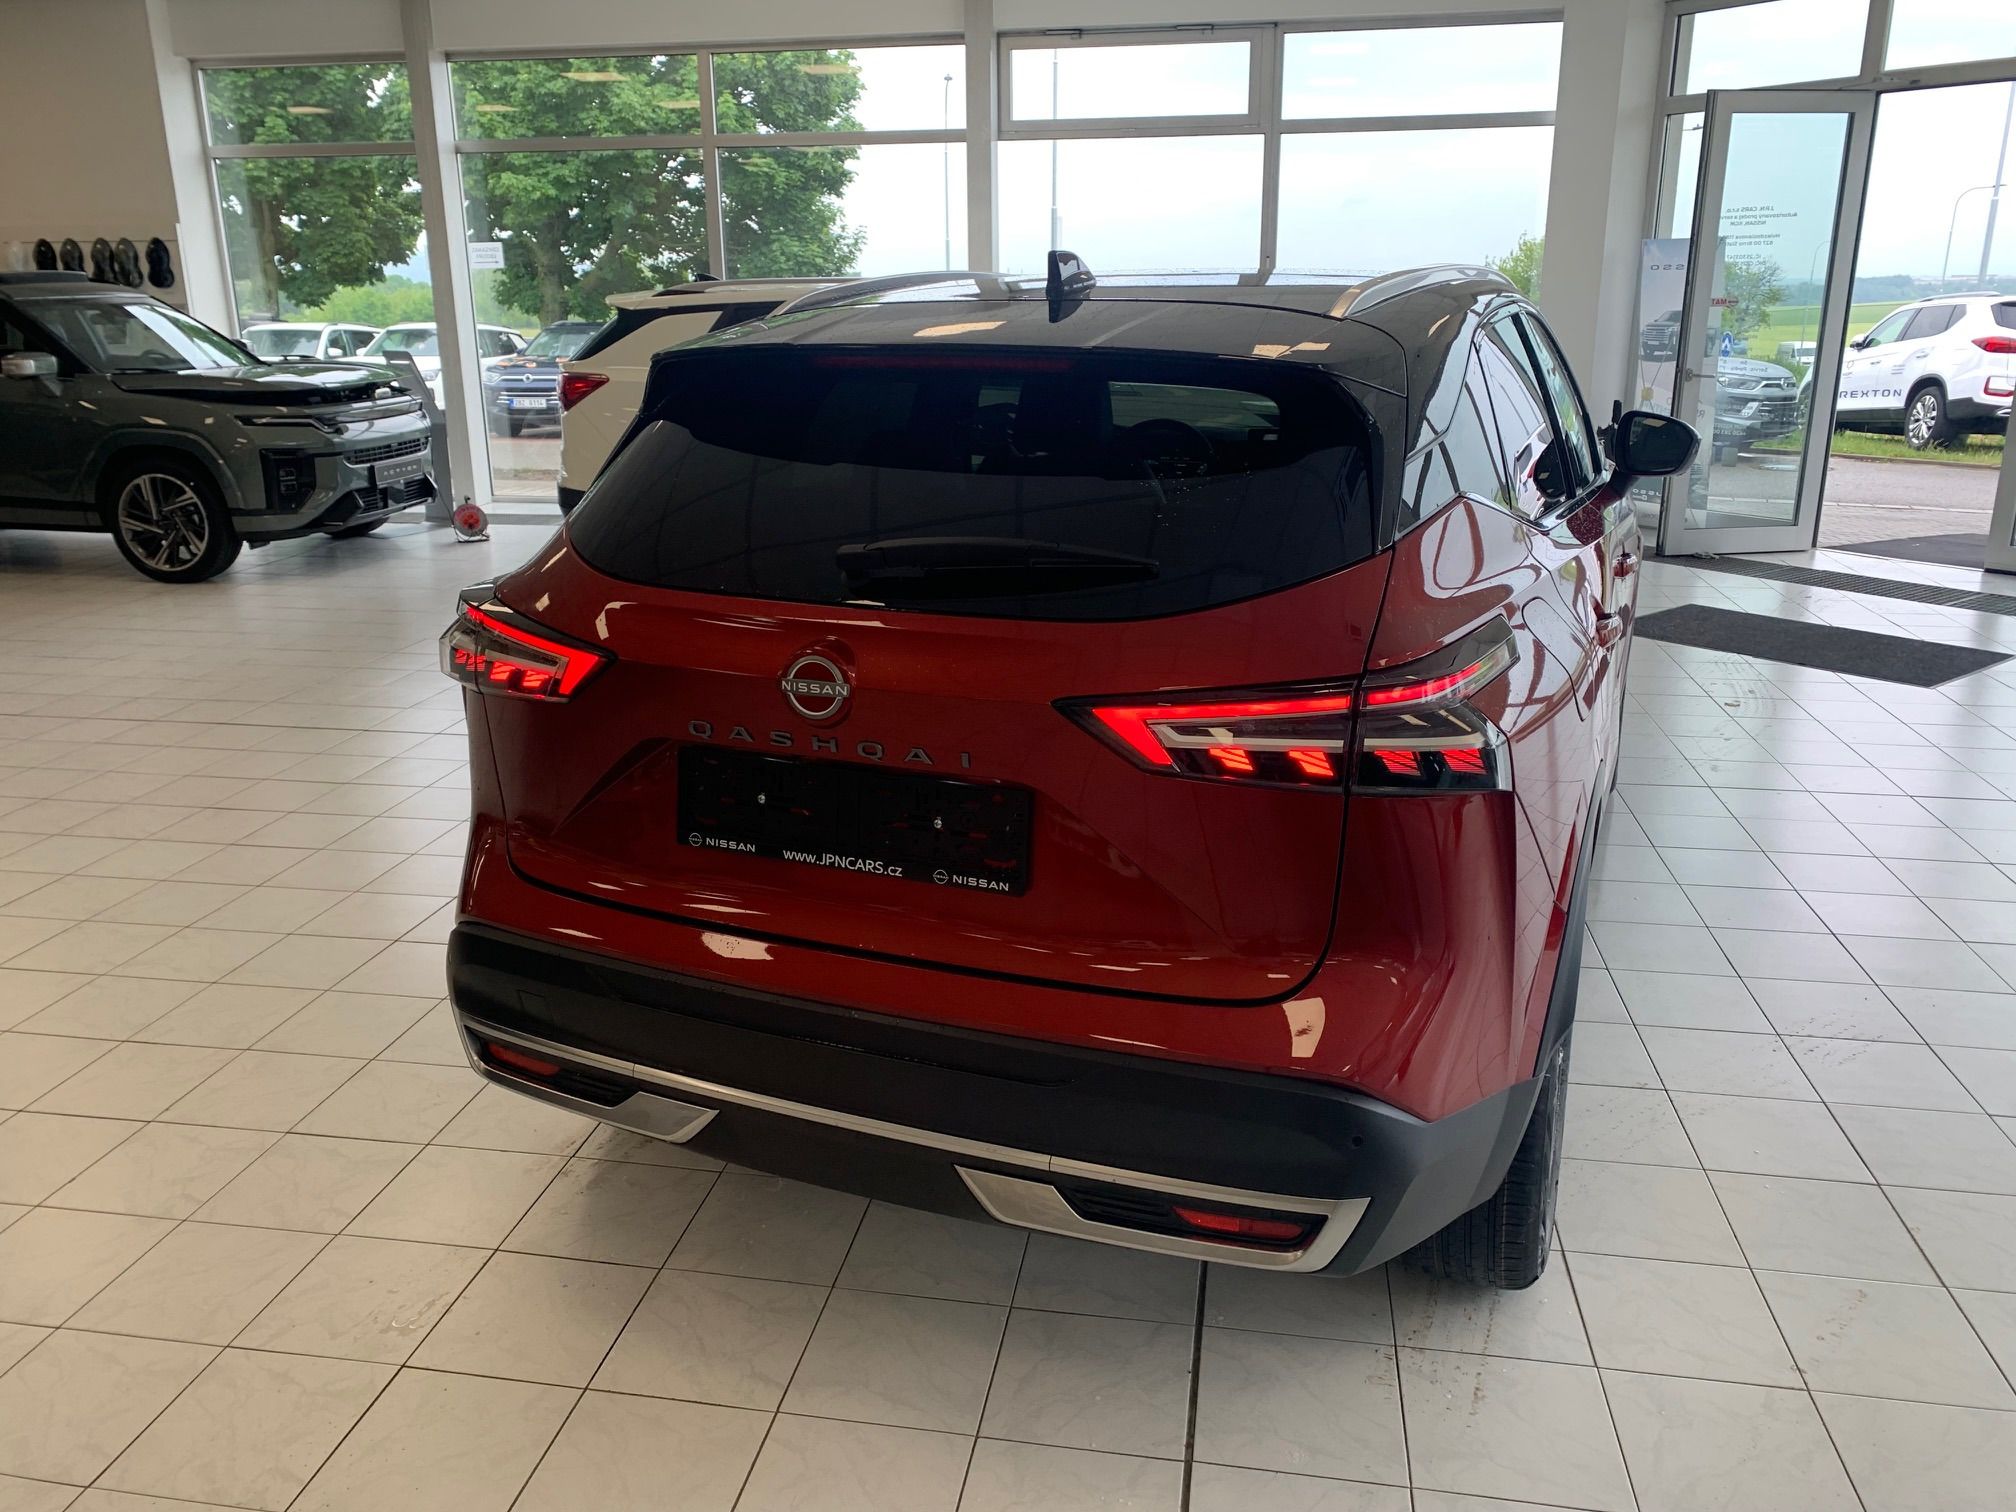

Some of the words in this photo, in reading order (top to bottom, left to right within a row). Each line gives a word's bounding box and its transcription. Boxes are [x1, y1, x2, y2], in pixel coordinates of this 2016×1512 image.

[1839, 388, 1902, 398] REXTON
[781, 679, 849, 697] NISSAN
[688, 720, 973, 769] QASHQAI
[706, 837, 756, 853] NISSAN
[783, 849, 903, 877] www.JPNCARS.cz
[952, 874, 1009, 891] NISSAN
